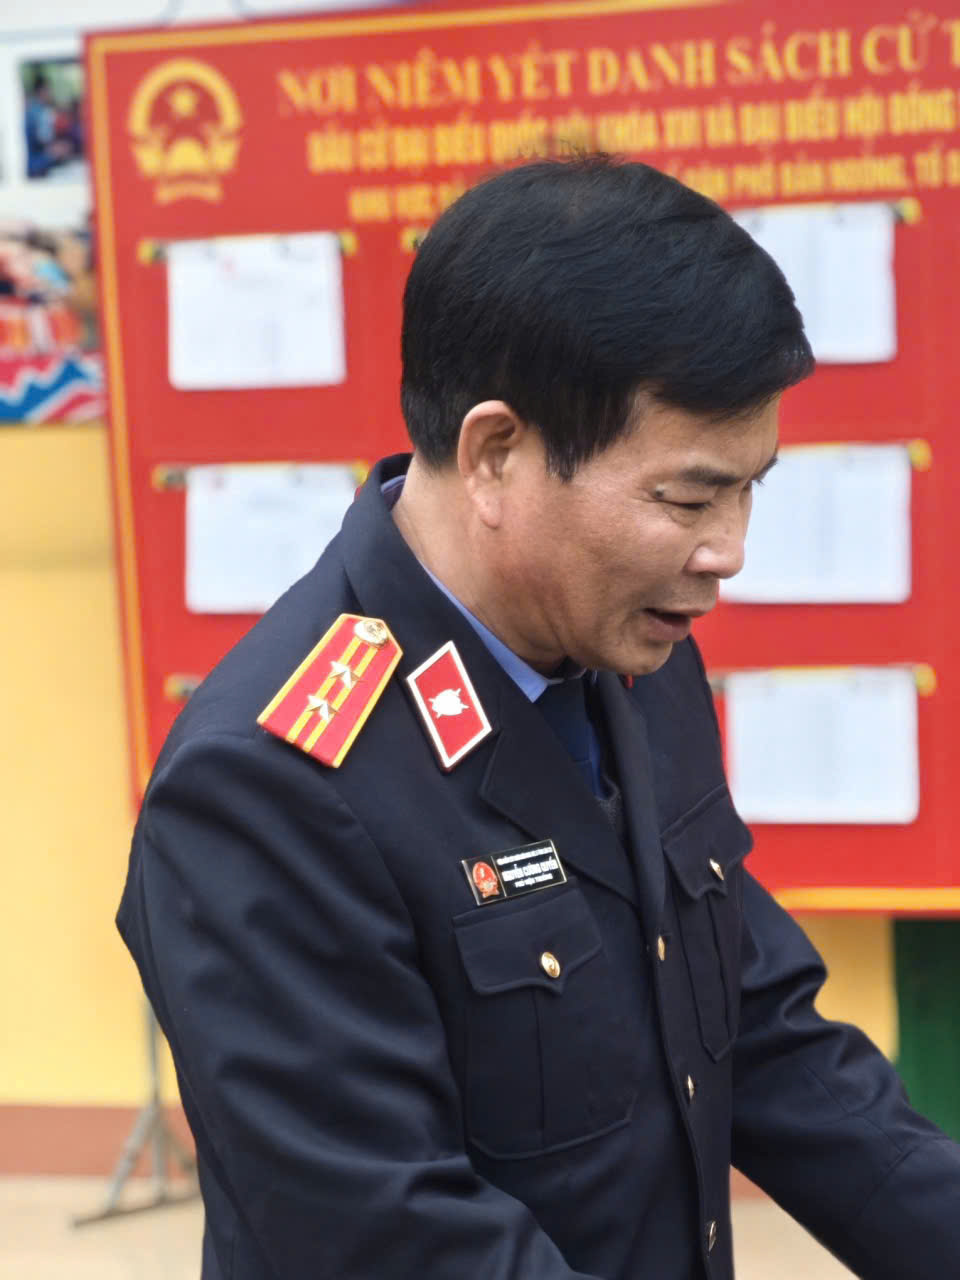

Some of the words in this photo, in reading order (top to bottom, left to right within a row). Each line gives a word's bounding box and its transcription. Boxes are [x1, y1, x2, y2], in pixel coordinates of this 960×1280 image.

[366, 45, 481, 110] NIÊM
[487, 38, 578, 101] YẾT
[587, 39, 716, 95] DANH
[725, 20, 850, 84] SÁCH
[861, 8, 937, 76] CỬ
[784, 82, 839, 143] BIỂU
[888, 78, 956, 136] ĐỒNG
